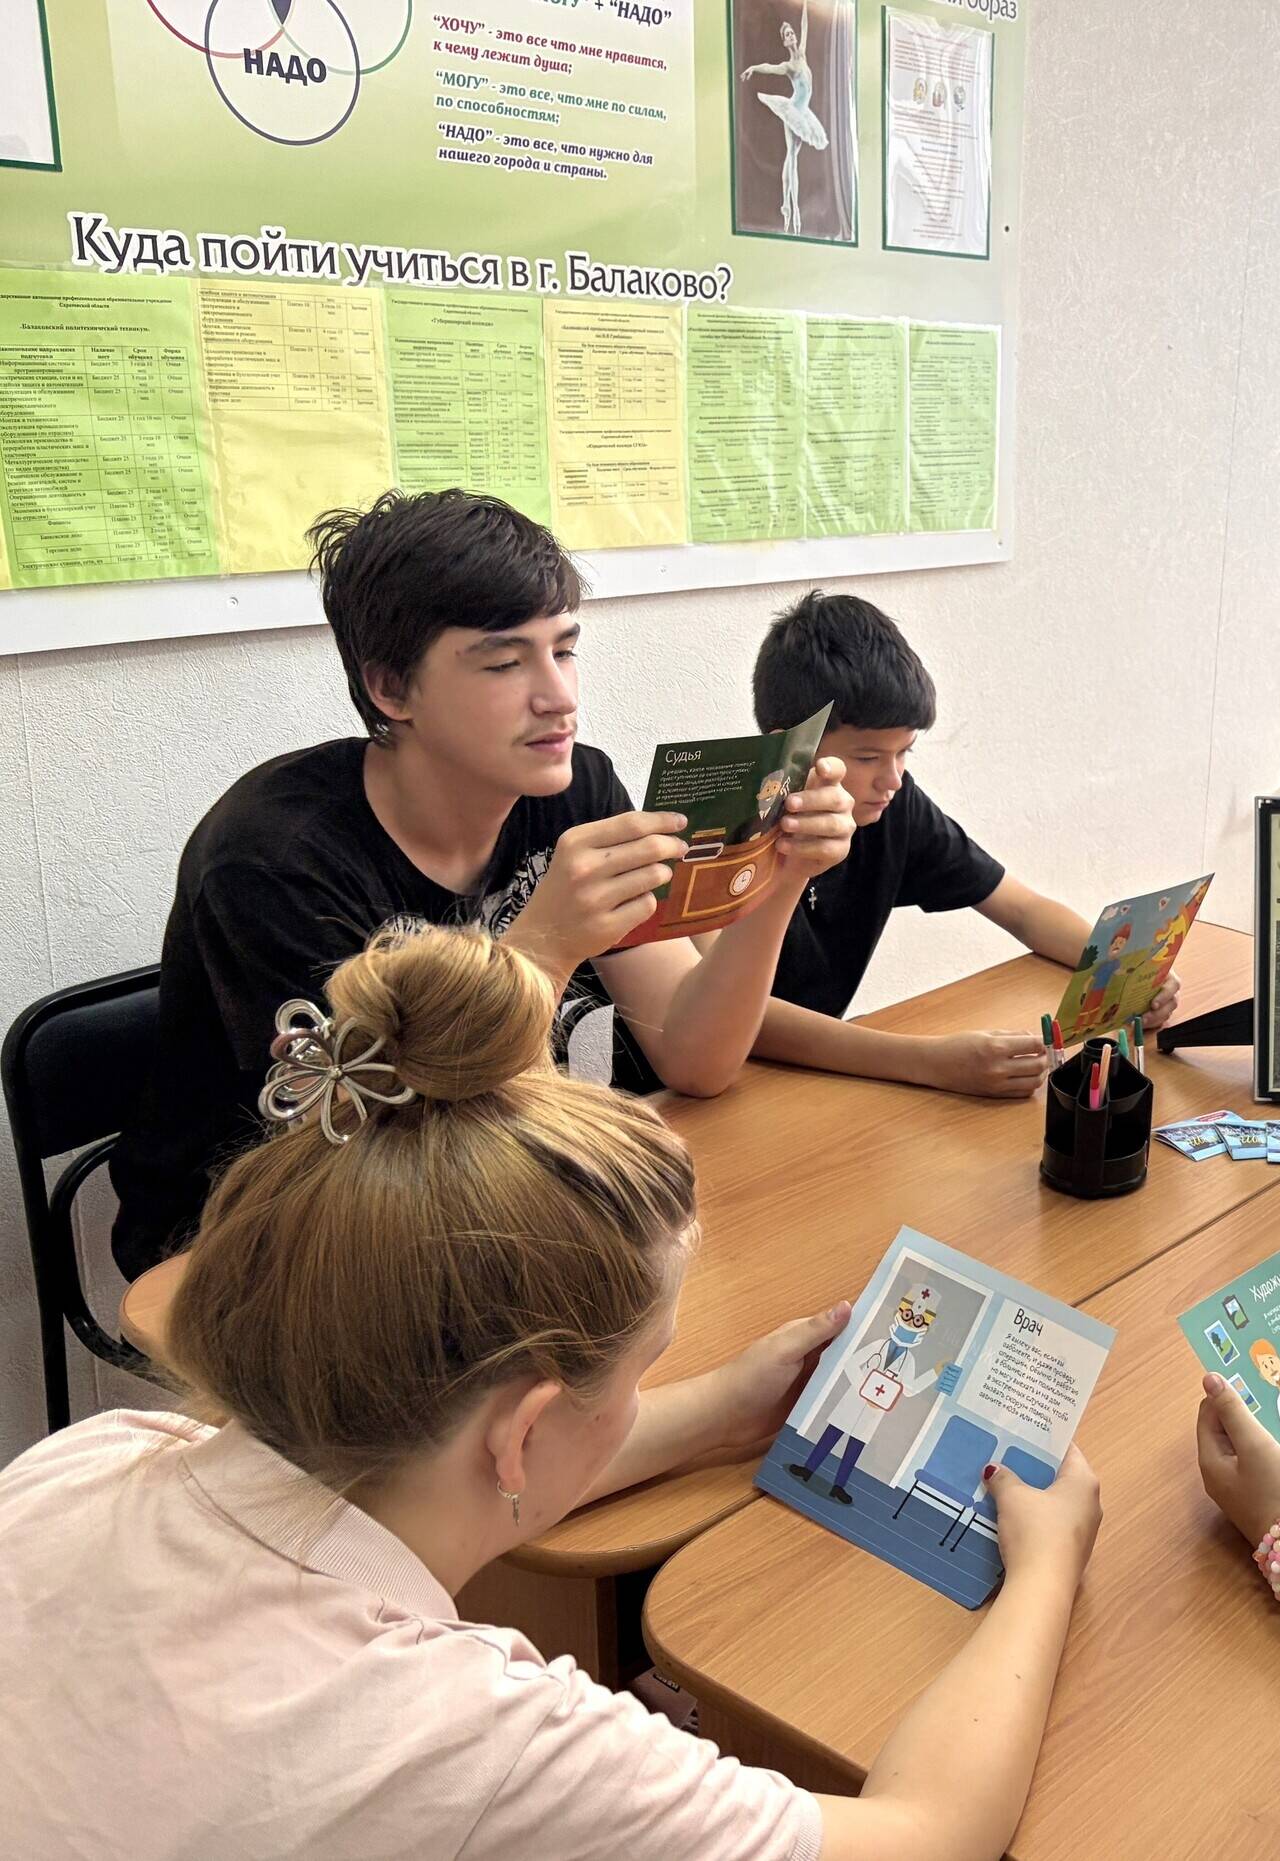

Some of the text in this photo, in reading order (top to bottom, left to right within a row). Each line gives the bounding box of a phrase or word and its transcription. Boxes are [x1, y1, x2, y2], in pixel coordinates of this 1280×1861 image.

[433, 14, 485, 35] “ХОЧУ”
[496, 29, 523, 43] это
[526, 36, 548, 47] все
[550, 40, 576, 53] что
[579, 45, 603, 58] мне
[605, 50, 668, 71] нравится,
[433, 41, 573, 74] к чему лежит душа;
[243, 48, 327, 86] НАДО
[436, 71, 489, 90] “МОГУ”
[499, 84, 526, 97] это
[529, 89, 554, 103] все,
[557, 94, 584, 106] что
[585, 98, 608, 110] мне
[611, 101, 626, 113] по
[628, 105, 668, 120] силам,
[436, 96, 560, 124] по способностям;
[438, 123, 493, 143] “НАДО”
[503, 135, 530, 148] это
[533, 140, 558, 153] все,
[560, 143, 586, 156] что
[589, 148, 630, 166] нужно
[633, 151, 653, 165] для
[438, 148, 607, 179] нашего города и страны.
[73, 216, 731, 303] Куда пойти учиться в г. Балаково?
[665, 749, 702, 766] Судья
[1013, 1308, 1044, 1336] Врач
